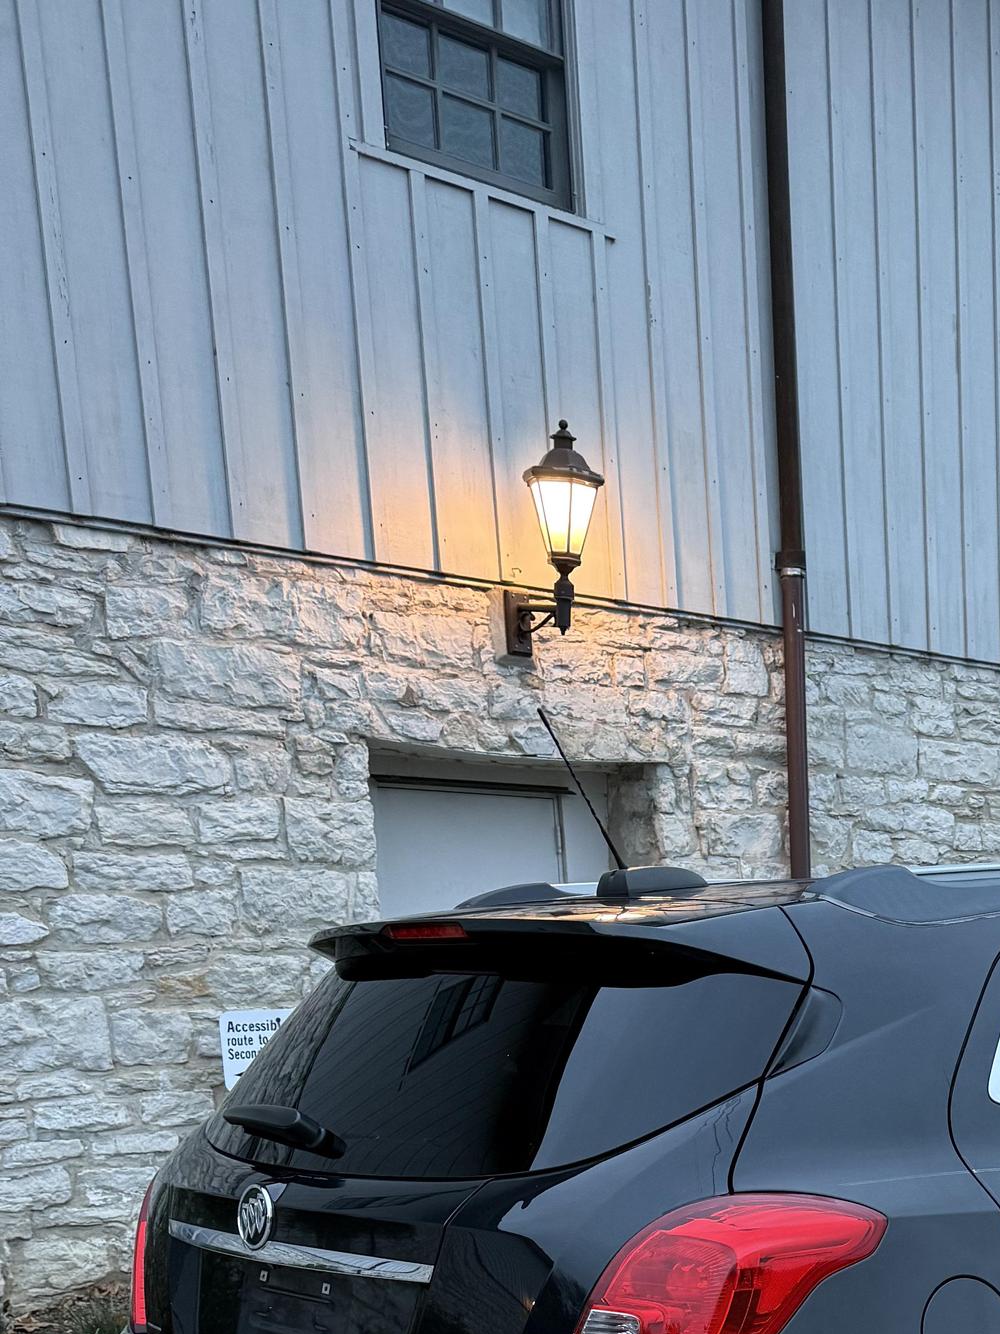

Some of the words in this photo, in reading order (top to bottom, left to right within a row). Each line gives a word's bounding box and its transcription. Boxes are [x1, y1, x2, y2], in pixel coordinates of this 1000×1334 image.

[227, 1035, 254, 1046] route
[259, 1034, 269, 1045] to
[228, 1048, 262, 1060] Secon
